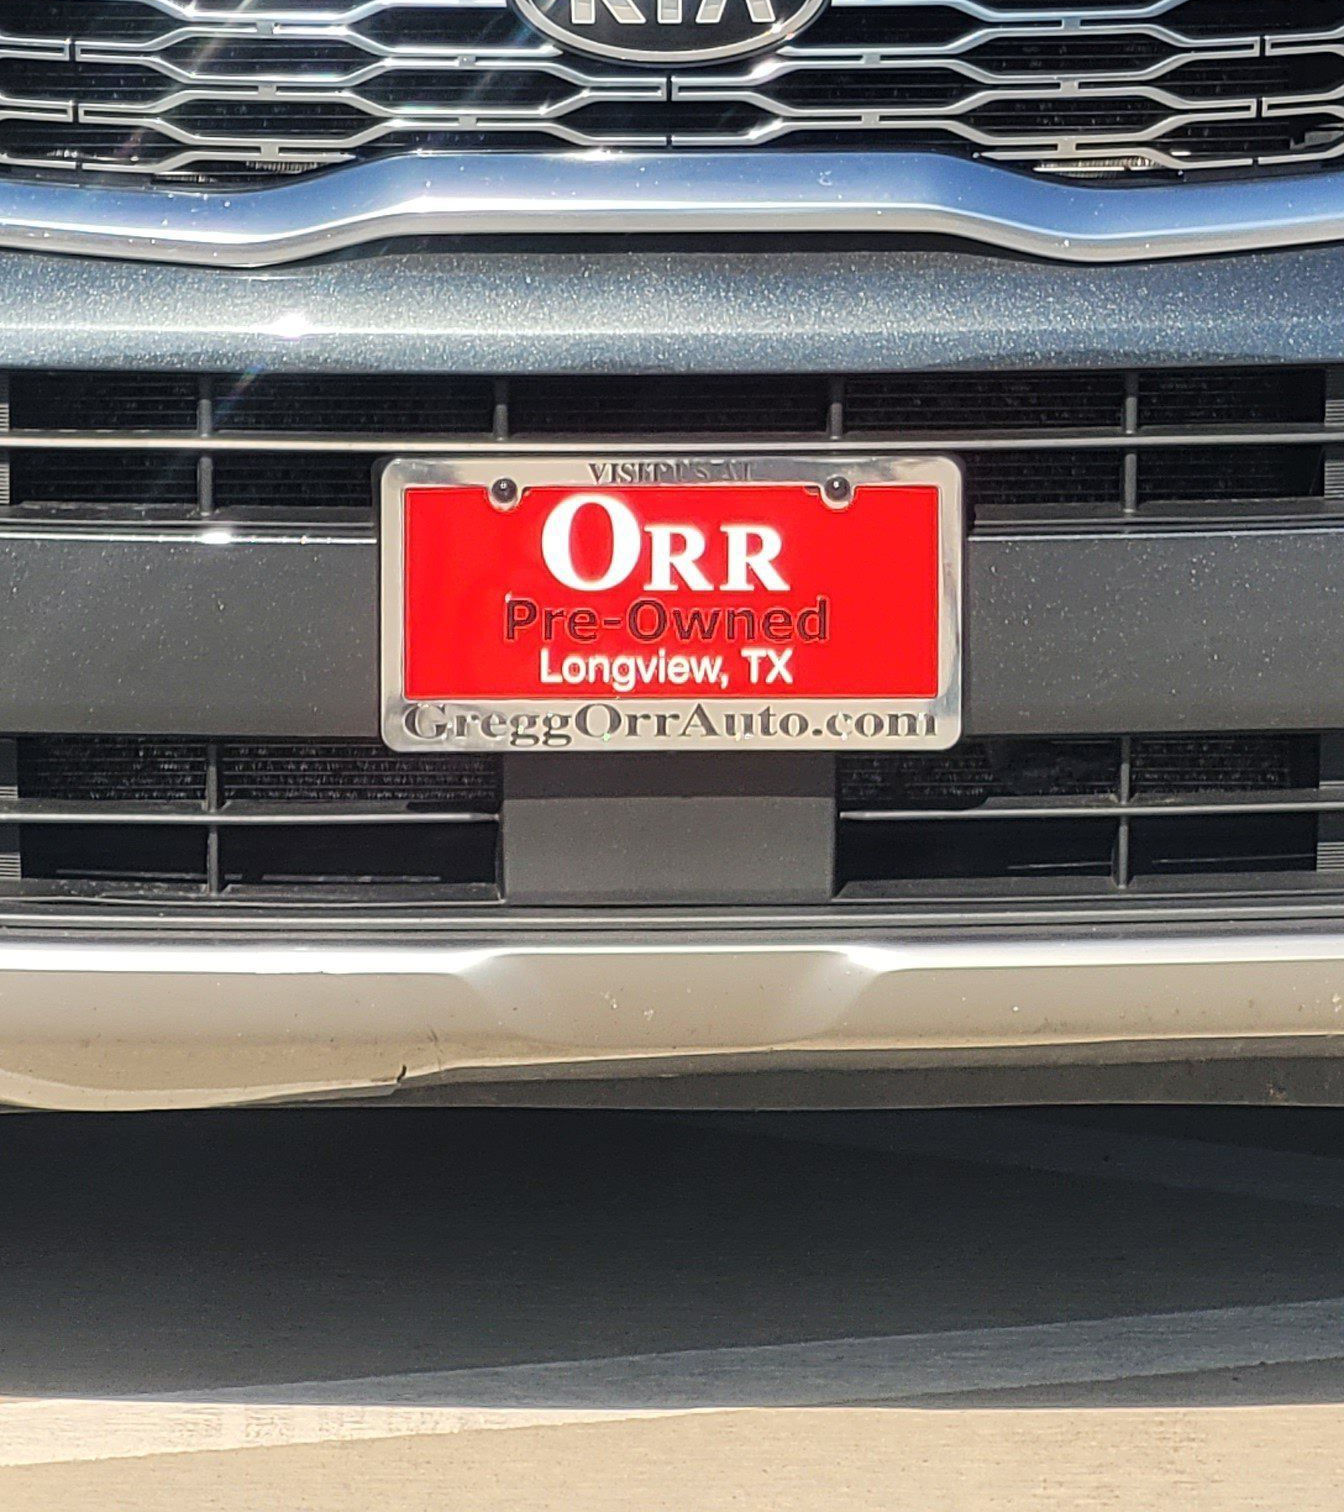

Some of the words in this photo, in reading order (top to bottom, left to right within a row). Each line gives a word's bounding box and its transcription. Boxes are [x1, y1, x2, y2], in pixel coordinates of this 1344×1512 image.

[588, 462, 668, 485] VISIT
[504, 598, 829, 642] Pre-Owned
[540, 648, 730, 690] Longview,
[741, 648, 794, 684] TX
[404, 702, 938, 748] GreggOrrAuto.com
